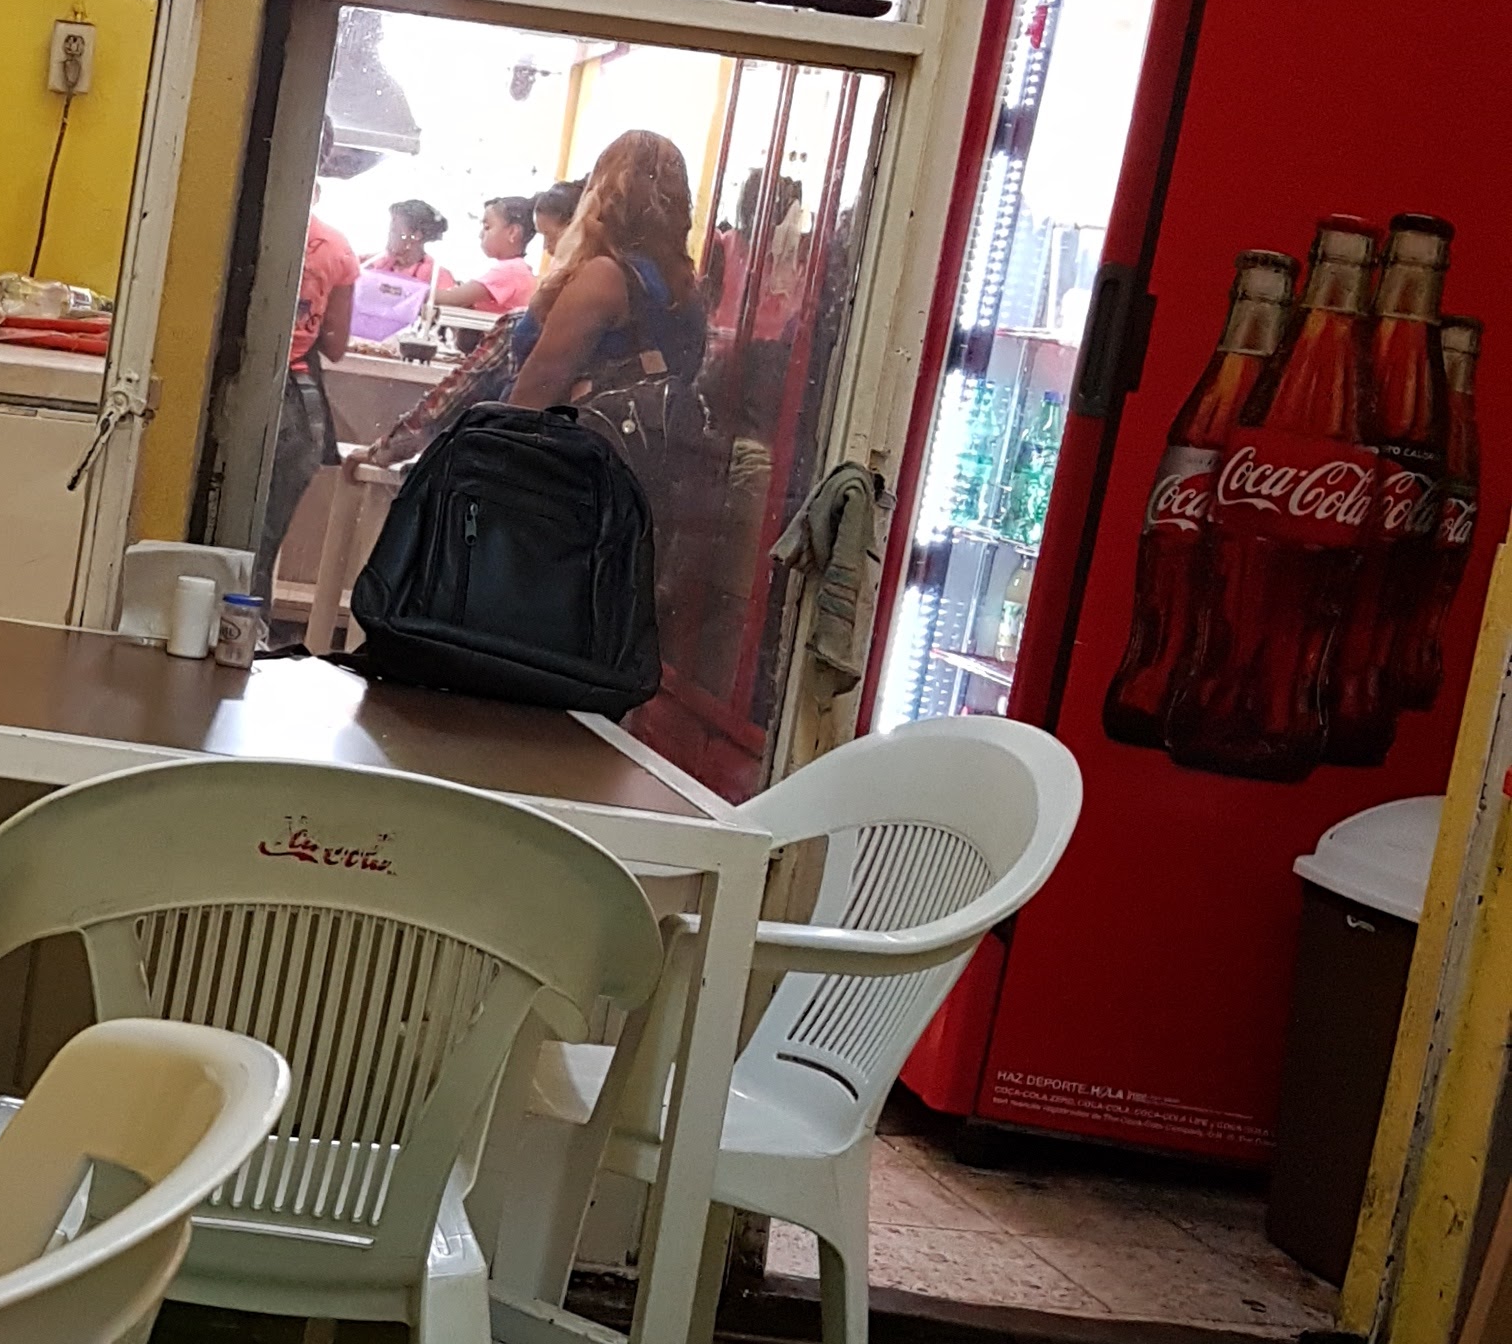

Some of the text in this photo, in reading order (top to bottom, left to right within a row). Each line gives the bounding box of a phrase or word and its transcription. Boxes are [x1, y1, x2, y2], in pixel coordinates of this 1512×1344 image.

[1217, 446, 1376, 526] Coca-Cola
[997, 1069, 1024, 1085] HAZ
[1026, 1074, 1088, 1095] DEPORTE
